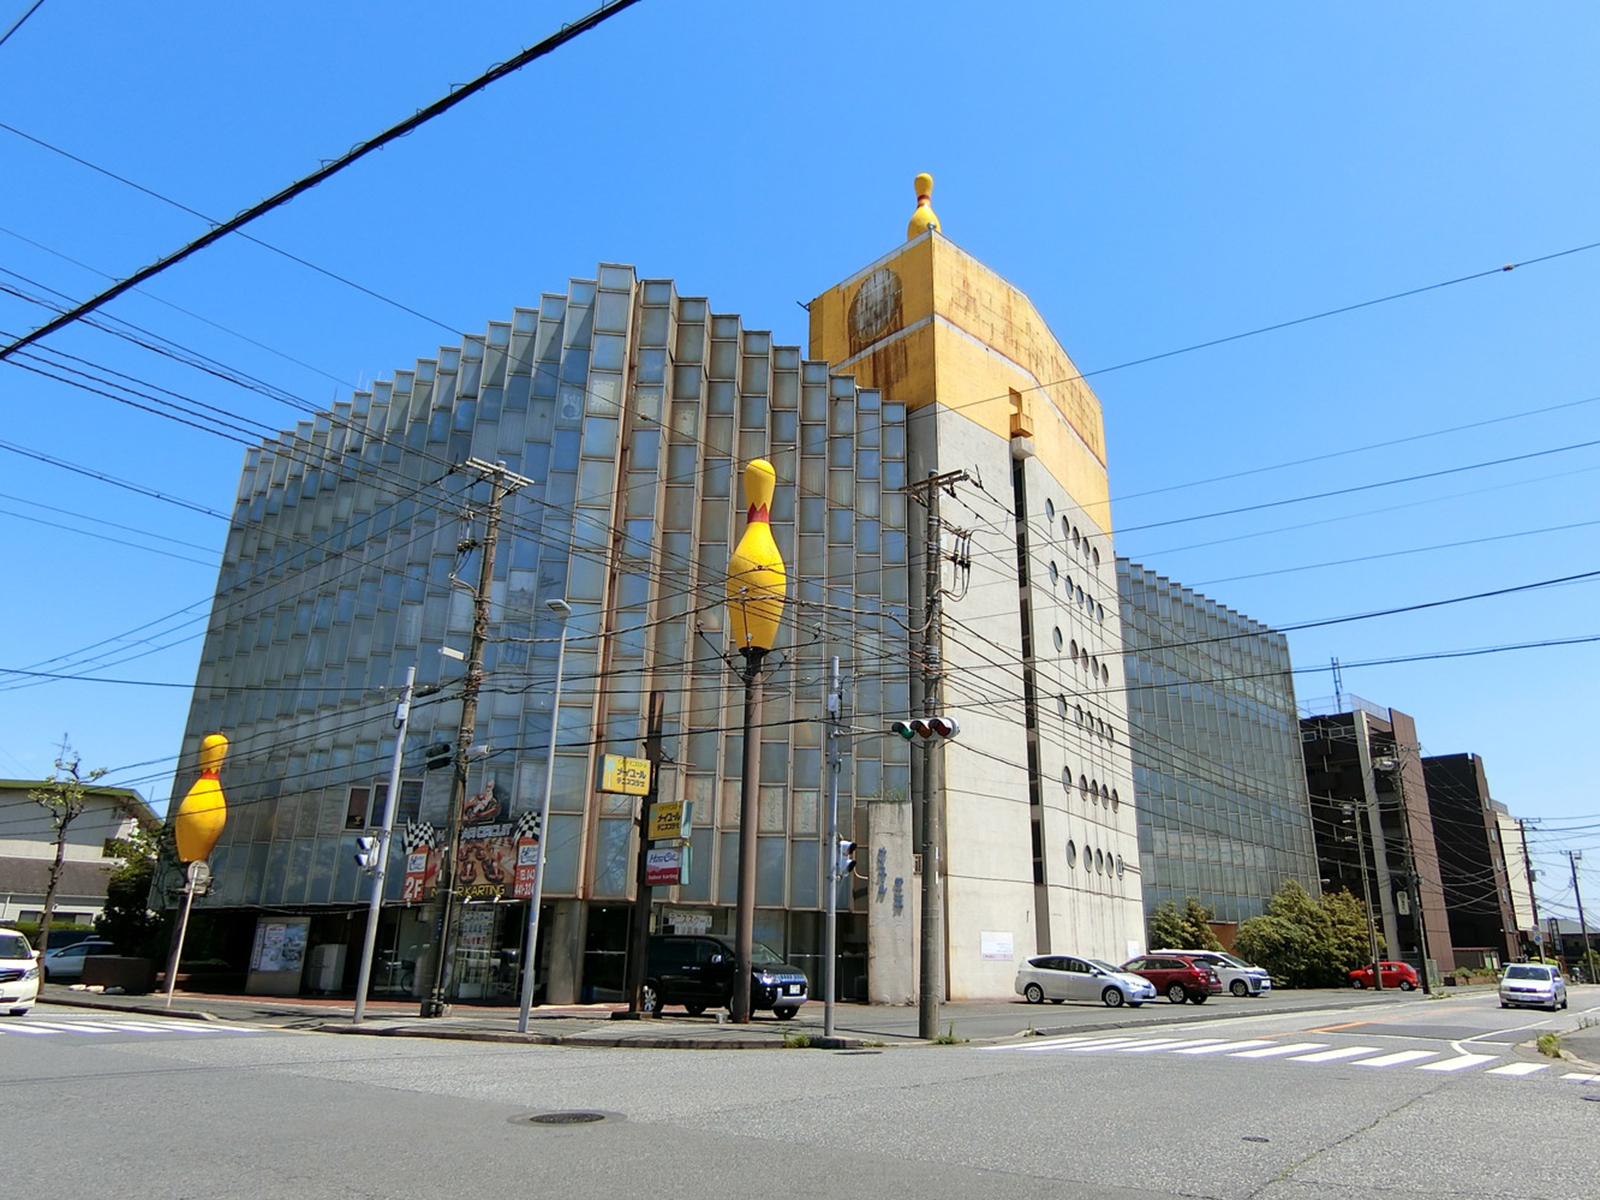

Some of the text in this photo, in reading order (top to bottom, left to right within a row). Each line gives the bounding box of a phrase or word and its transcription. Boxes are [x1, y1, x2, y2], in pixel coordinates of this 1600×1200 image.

[477, 823, 513, 838] CIRCUIT
[404, 877, 423, 899] 2F
[465, 884, 505, 896] KARTING
